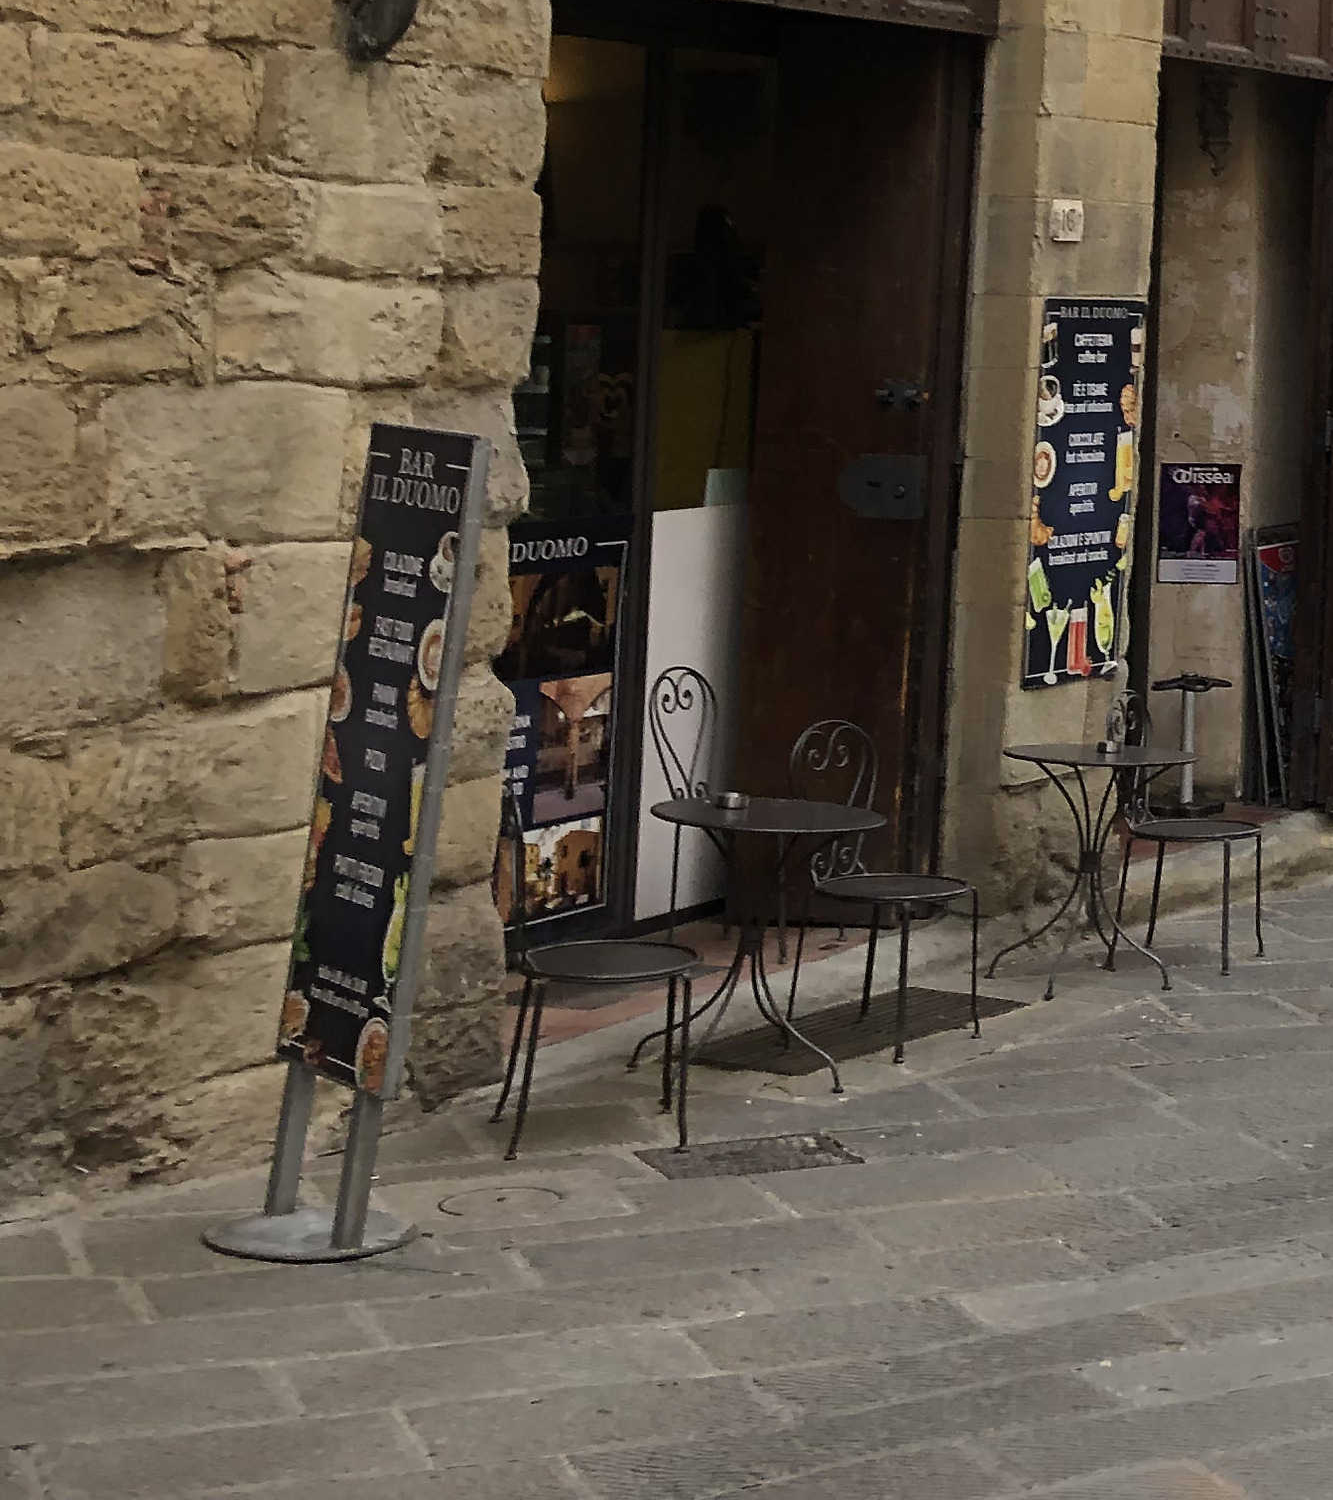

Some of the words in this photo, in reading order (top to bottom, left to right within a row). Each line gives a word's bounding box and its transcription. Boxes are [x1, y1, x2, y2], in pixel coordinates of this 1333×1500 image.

[1093, 306, 1128, 318] DUOMO
[398, 447, 436, 479] BAR
[371, 474, 388, 501] IL
[392, 476, 461, 514] DUOMO
[511, 536, 588, 563] DUOMO
